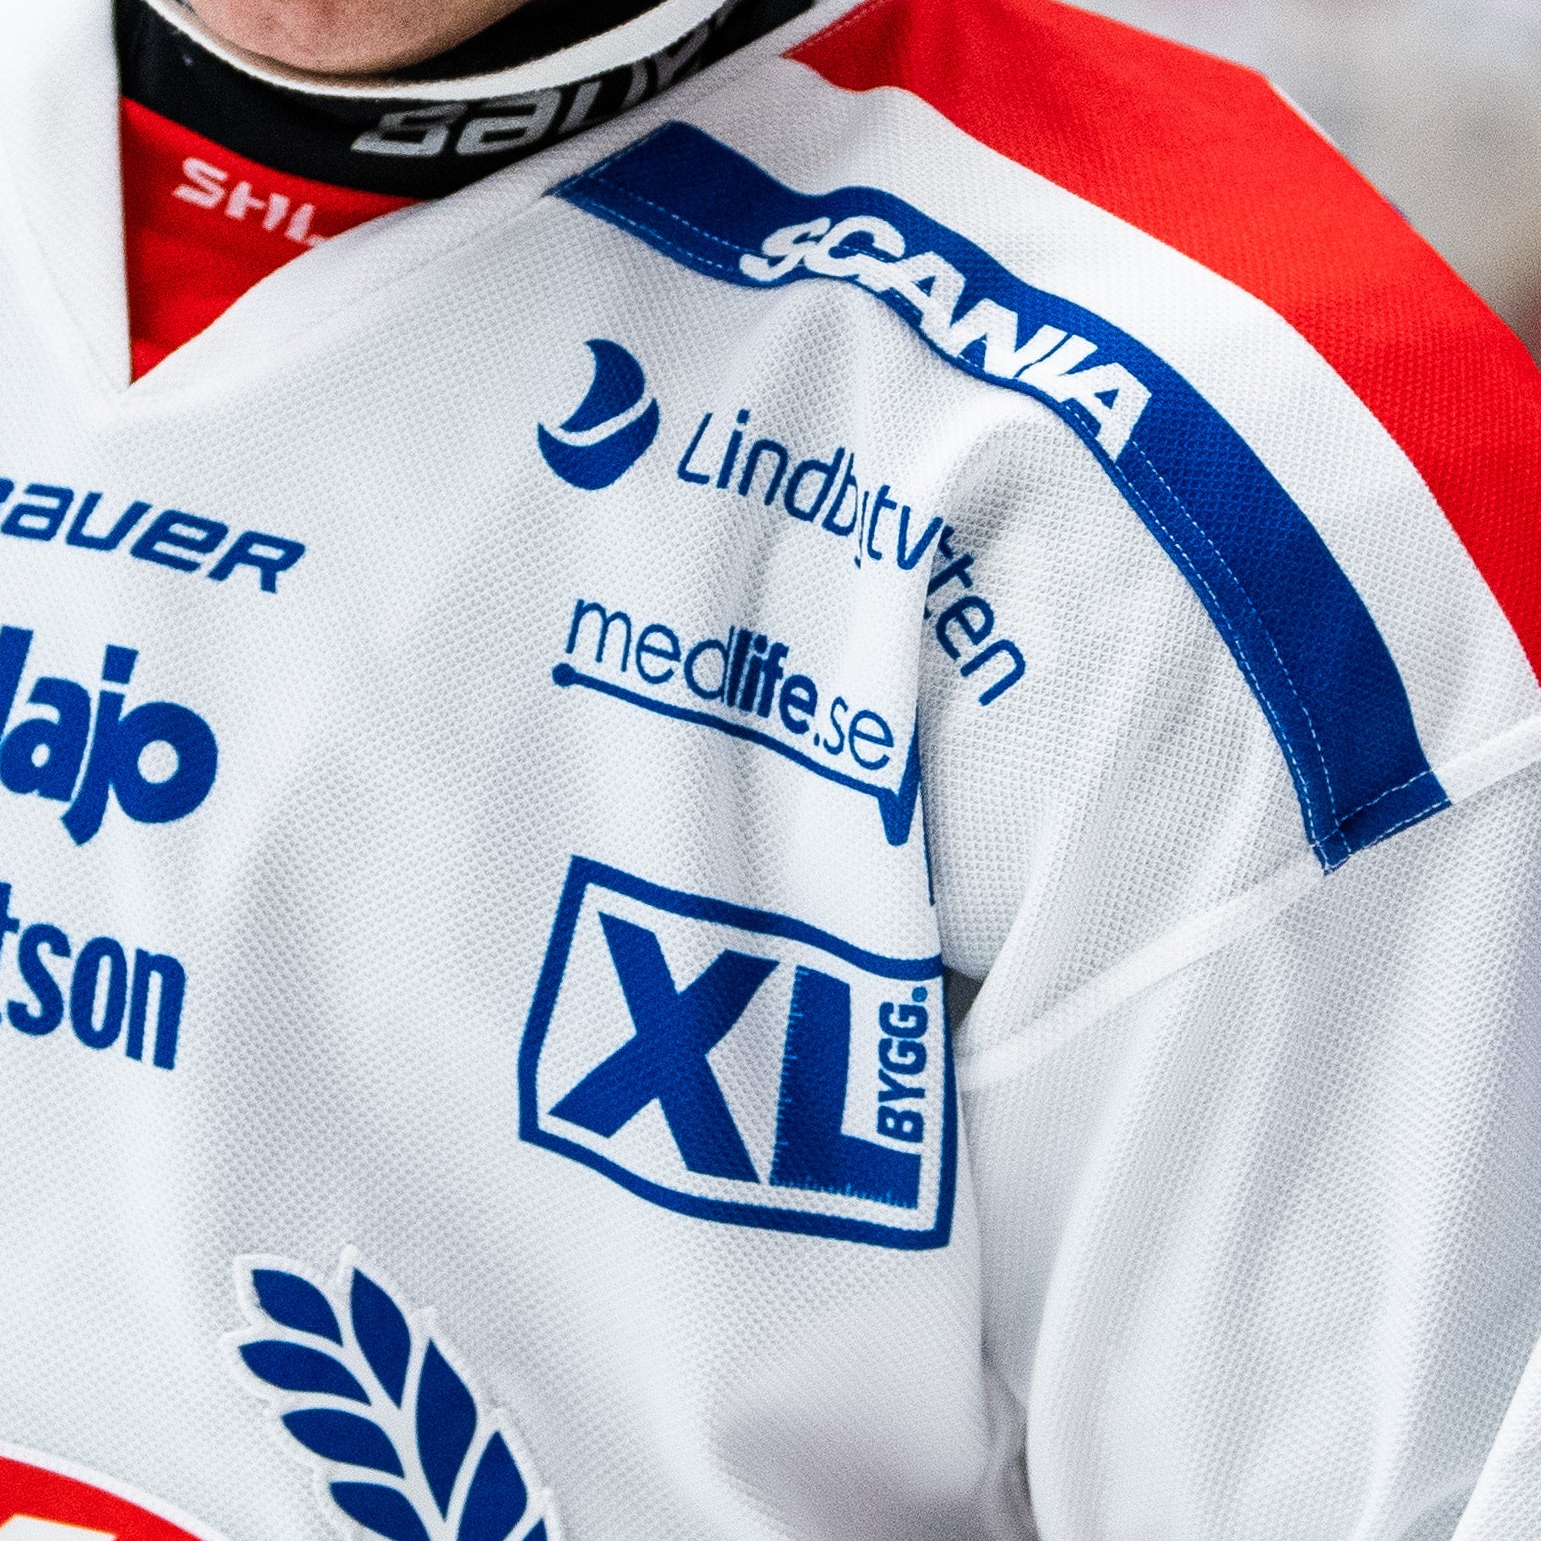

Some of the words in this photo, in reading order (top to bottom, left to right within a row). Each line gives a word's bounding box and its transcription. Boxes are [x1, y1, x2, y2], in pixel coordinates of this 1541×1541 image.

[739, 214, 1153, 461] SCANIA
[565, 598, 894, 770] medlife.se
[547, 911, 923, 1210] XL
